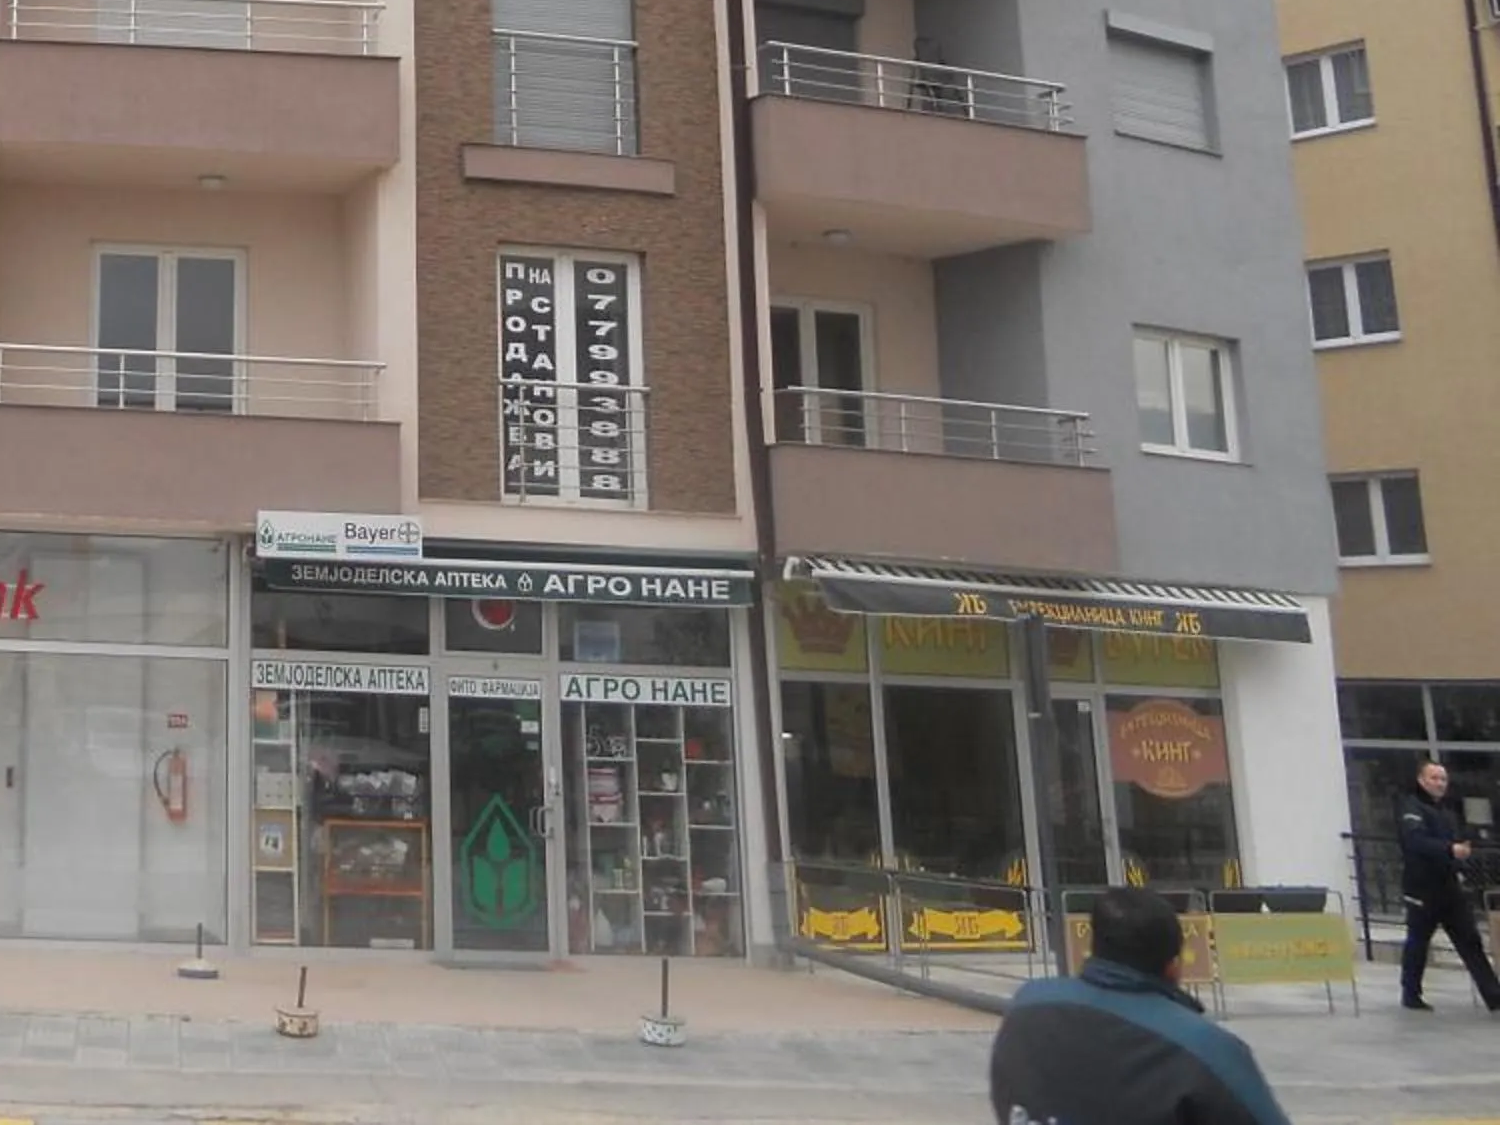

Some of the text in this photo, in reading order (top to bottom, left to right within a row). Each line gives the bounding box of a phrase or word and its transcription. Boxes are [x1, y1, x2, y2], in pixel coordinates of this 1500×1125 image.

[529, 267, 552, 285] НА
[344, 522, 397, 544] Bayer
[291, 564, 731, 600] ЗЕМЈОДЕЛСКА АПТЕКА АГРО НАНЕ
[256, 663, 426, 691] ЗЕМЈОДЕЛСКА АПТЕКА
[564, 676, 728, 704] АГРО НАНЕ
[1142, 739, 1192, 764] КИНГ
